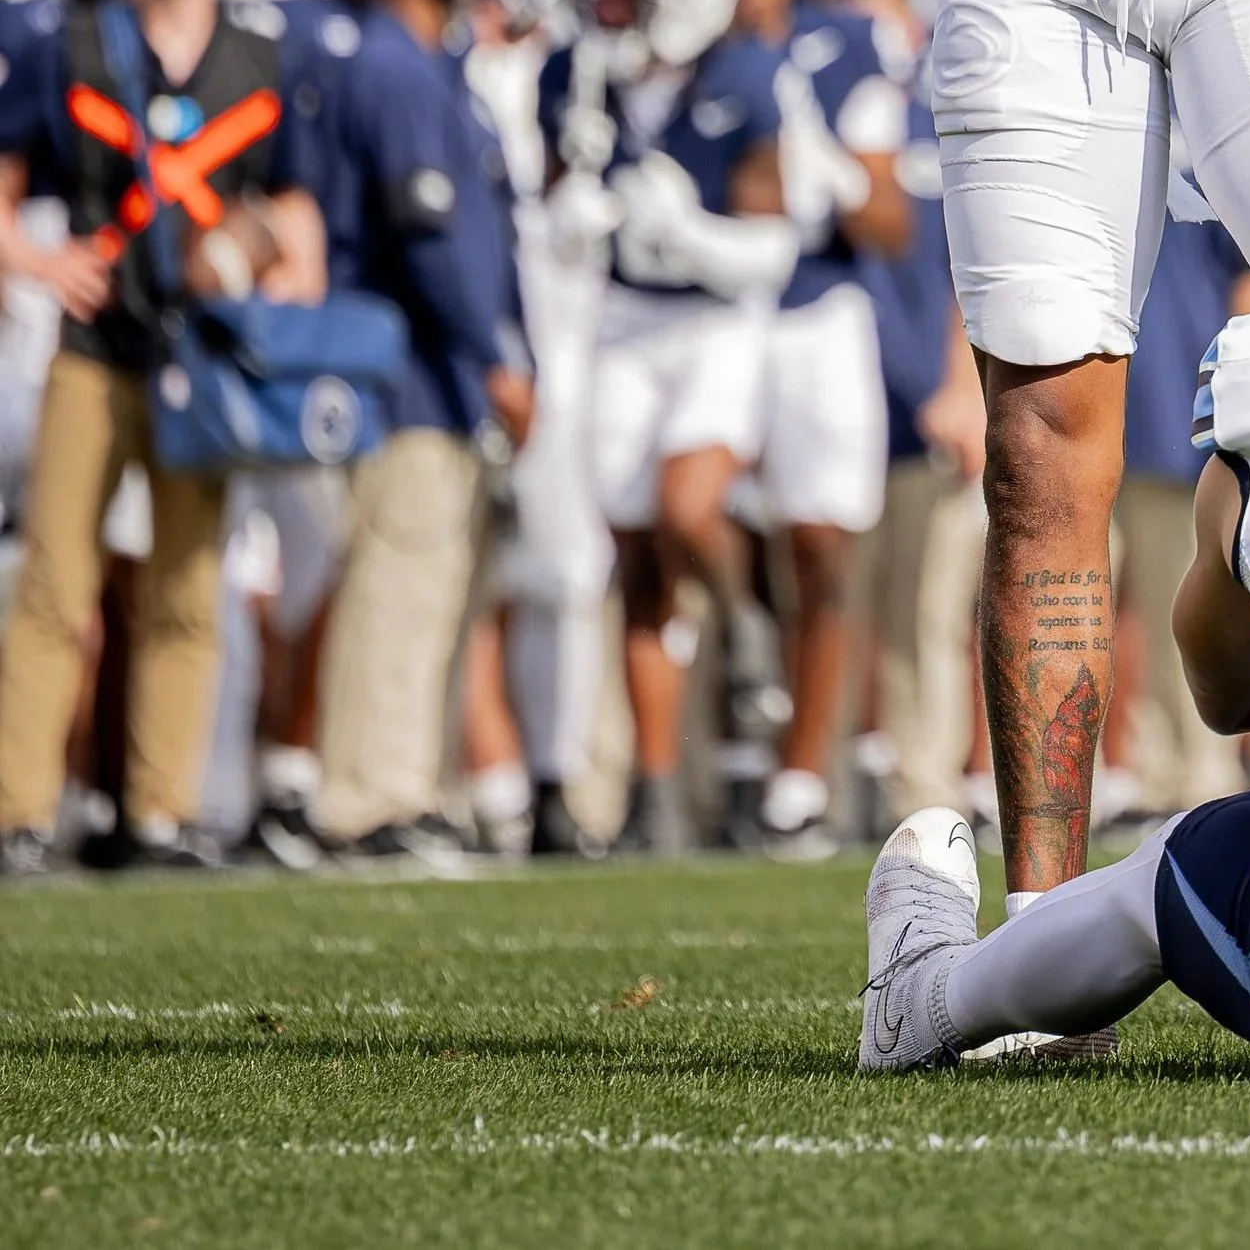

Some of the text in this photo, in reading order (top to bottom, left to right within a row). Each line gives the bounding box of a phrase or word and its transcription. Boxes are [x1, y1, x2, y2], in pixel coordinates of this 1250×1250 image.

[1039, 570, 1066, 587] God
[1070, 571, 1082, 584] is
[1083, 570, 1102, 587] for
[1031, 593, 1103, 607] who can be
[1037, 615, 1102, 630] against us
[1028, 637, 1088, 652] Romans
